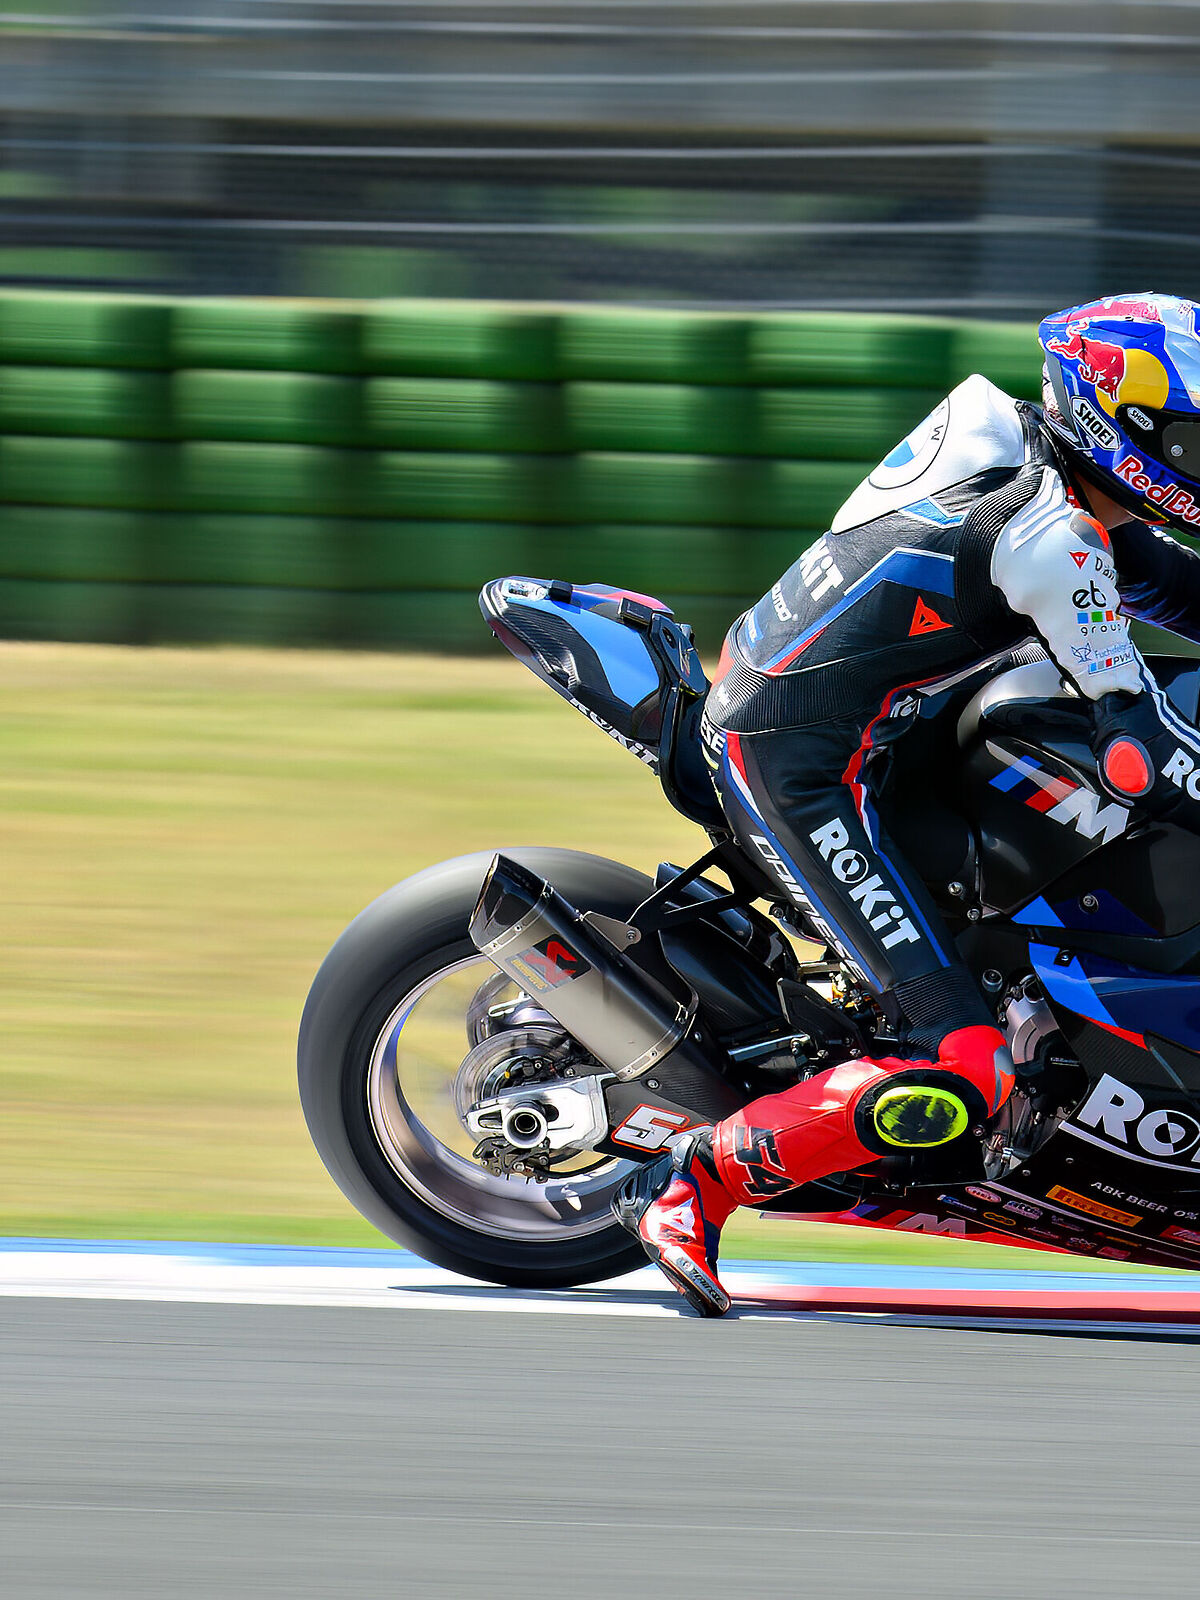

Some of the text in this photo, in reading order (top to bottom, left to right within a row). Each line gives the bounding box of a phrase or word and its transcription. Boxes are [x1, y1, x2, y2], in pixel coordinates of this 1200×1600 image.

[1075, 404, 1114, 446] SHOEI
[1131, 409, 1150, 429] SHOEI
[1112, 455, 1174, 505] Red
[1045, 786, 1130, 846] M
[809, 817, 921, 950] ROKiT
[1091, 1182, 1125, 1199] ABK
[1126, 1195, 1168, 1214] BEER
